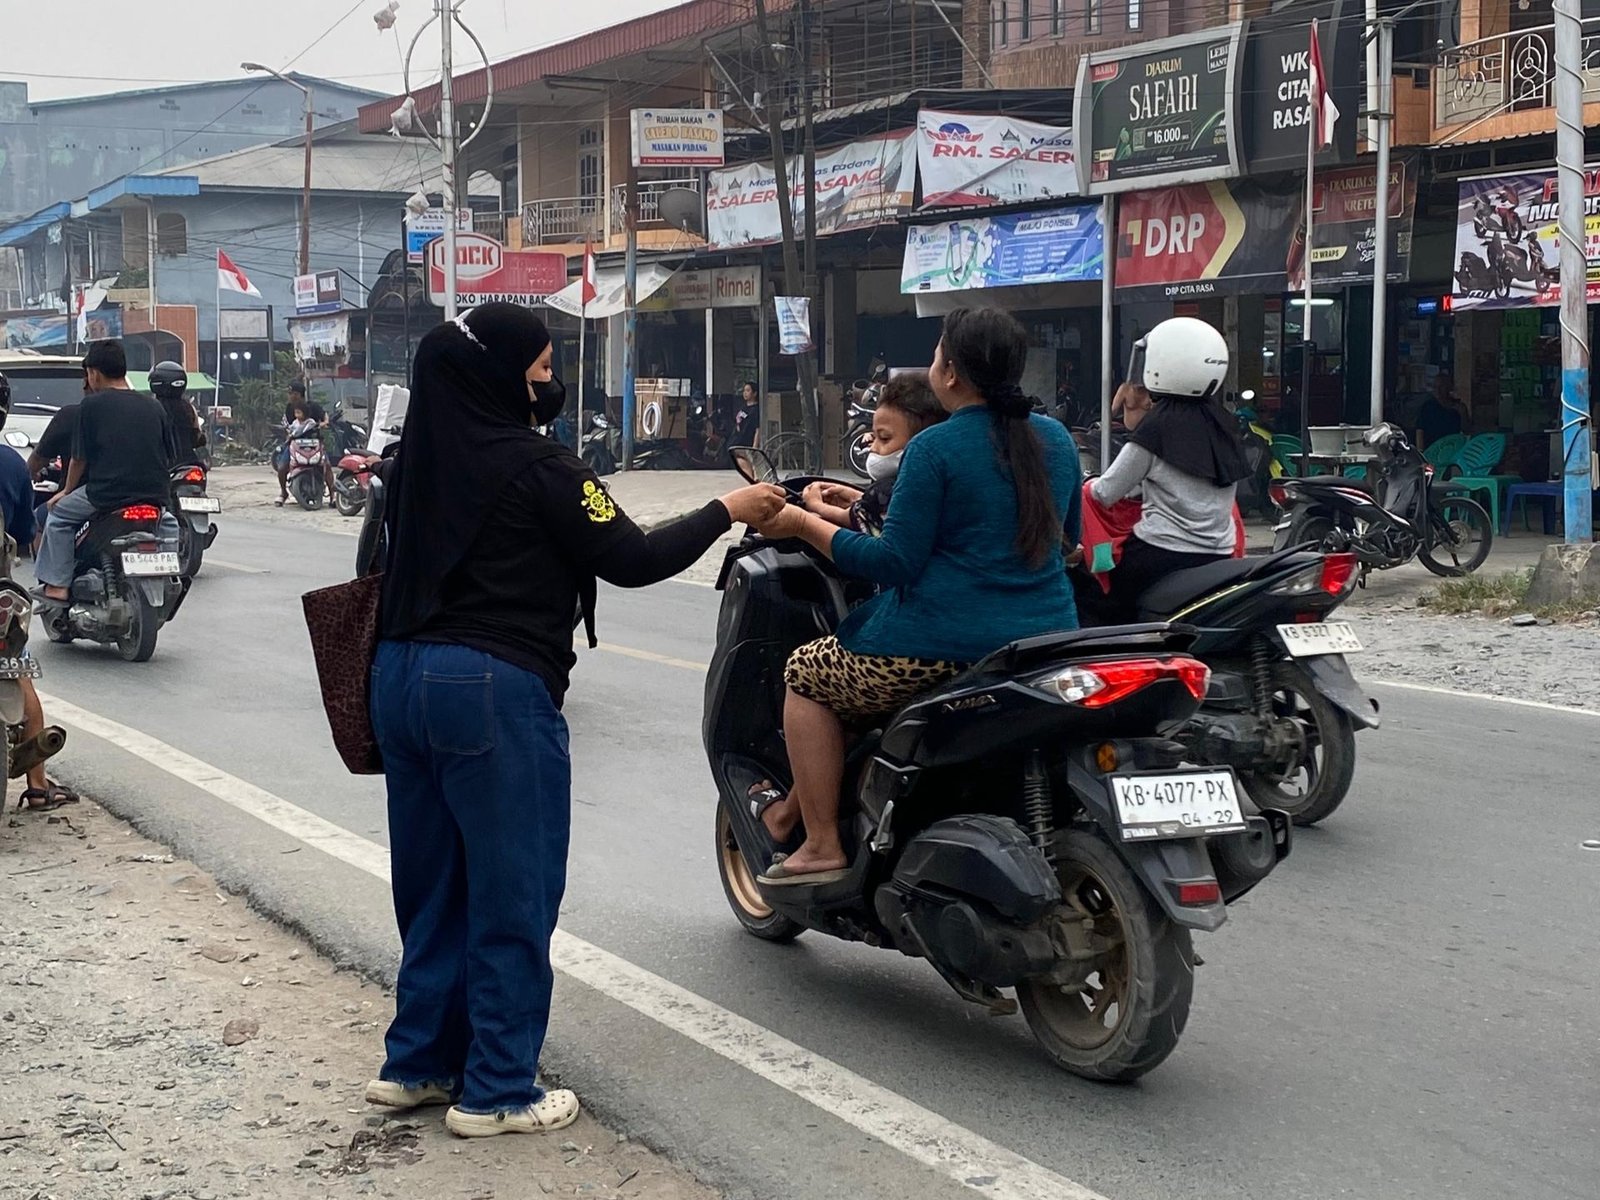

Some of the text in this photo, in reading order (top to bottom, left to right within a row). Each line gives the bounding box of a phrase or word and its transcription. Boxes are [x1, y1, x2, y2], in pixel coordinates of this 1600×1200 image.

[1145, 57, 1182, 77] DJARUM
[1129, 74, 1198, 121] SAFARI
[656, 115, 703, 124] RUMAH MAKAN
[1153, 127, 1181, 144] 16.000
[651, 143, 708, 152] MASAKAN PADANG
[932, 143, 983, 158] RM.
[1329, 176, 1367, 192] DJARUM
[1144, 212, 1205, 257] DRP
[1319, 249, 1339, 259] WRAPS
[716, 274, 755, 298] Rinnai
[1165, 283, 1215, 296] DRP CITA RASA
[480, 294, 527, 304] HARAPAN
[1282, 626, 1299, 639] KB
